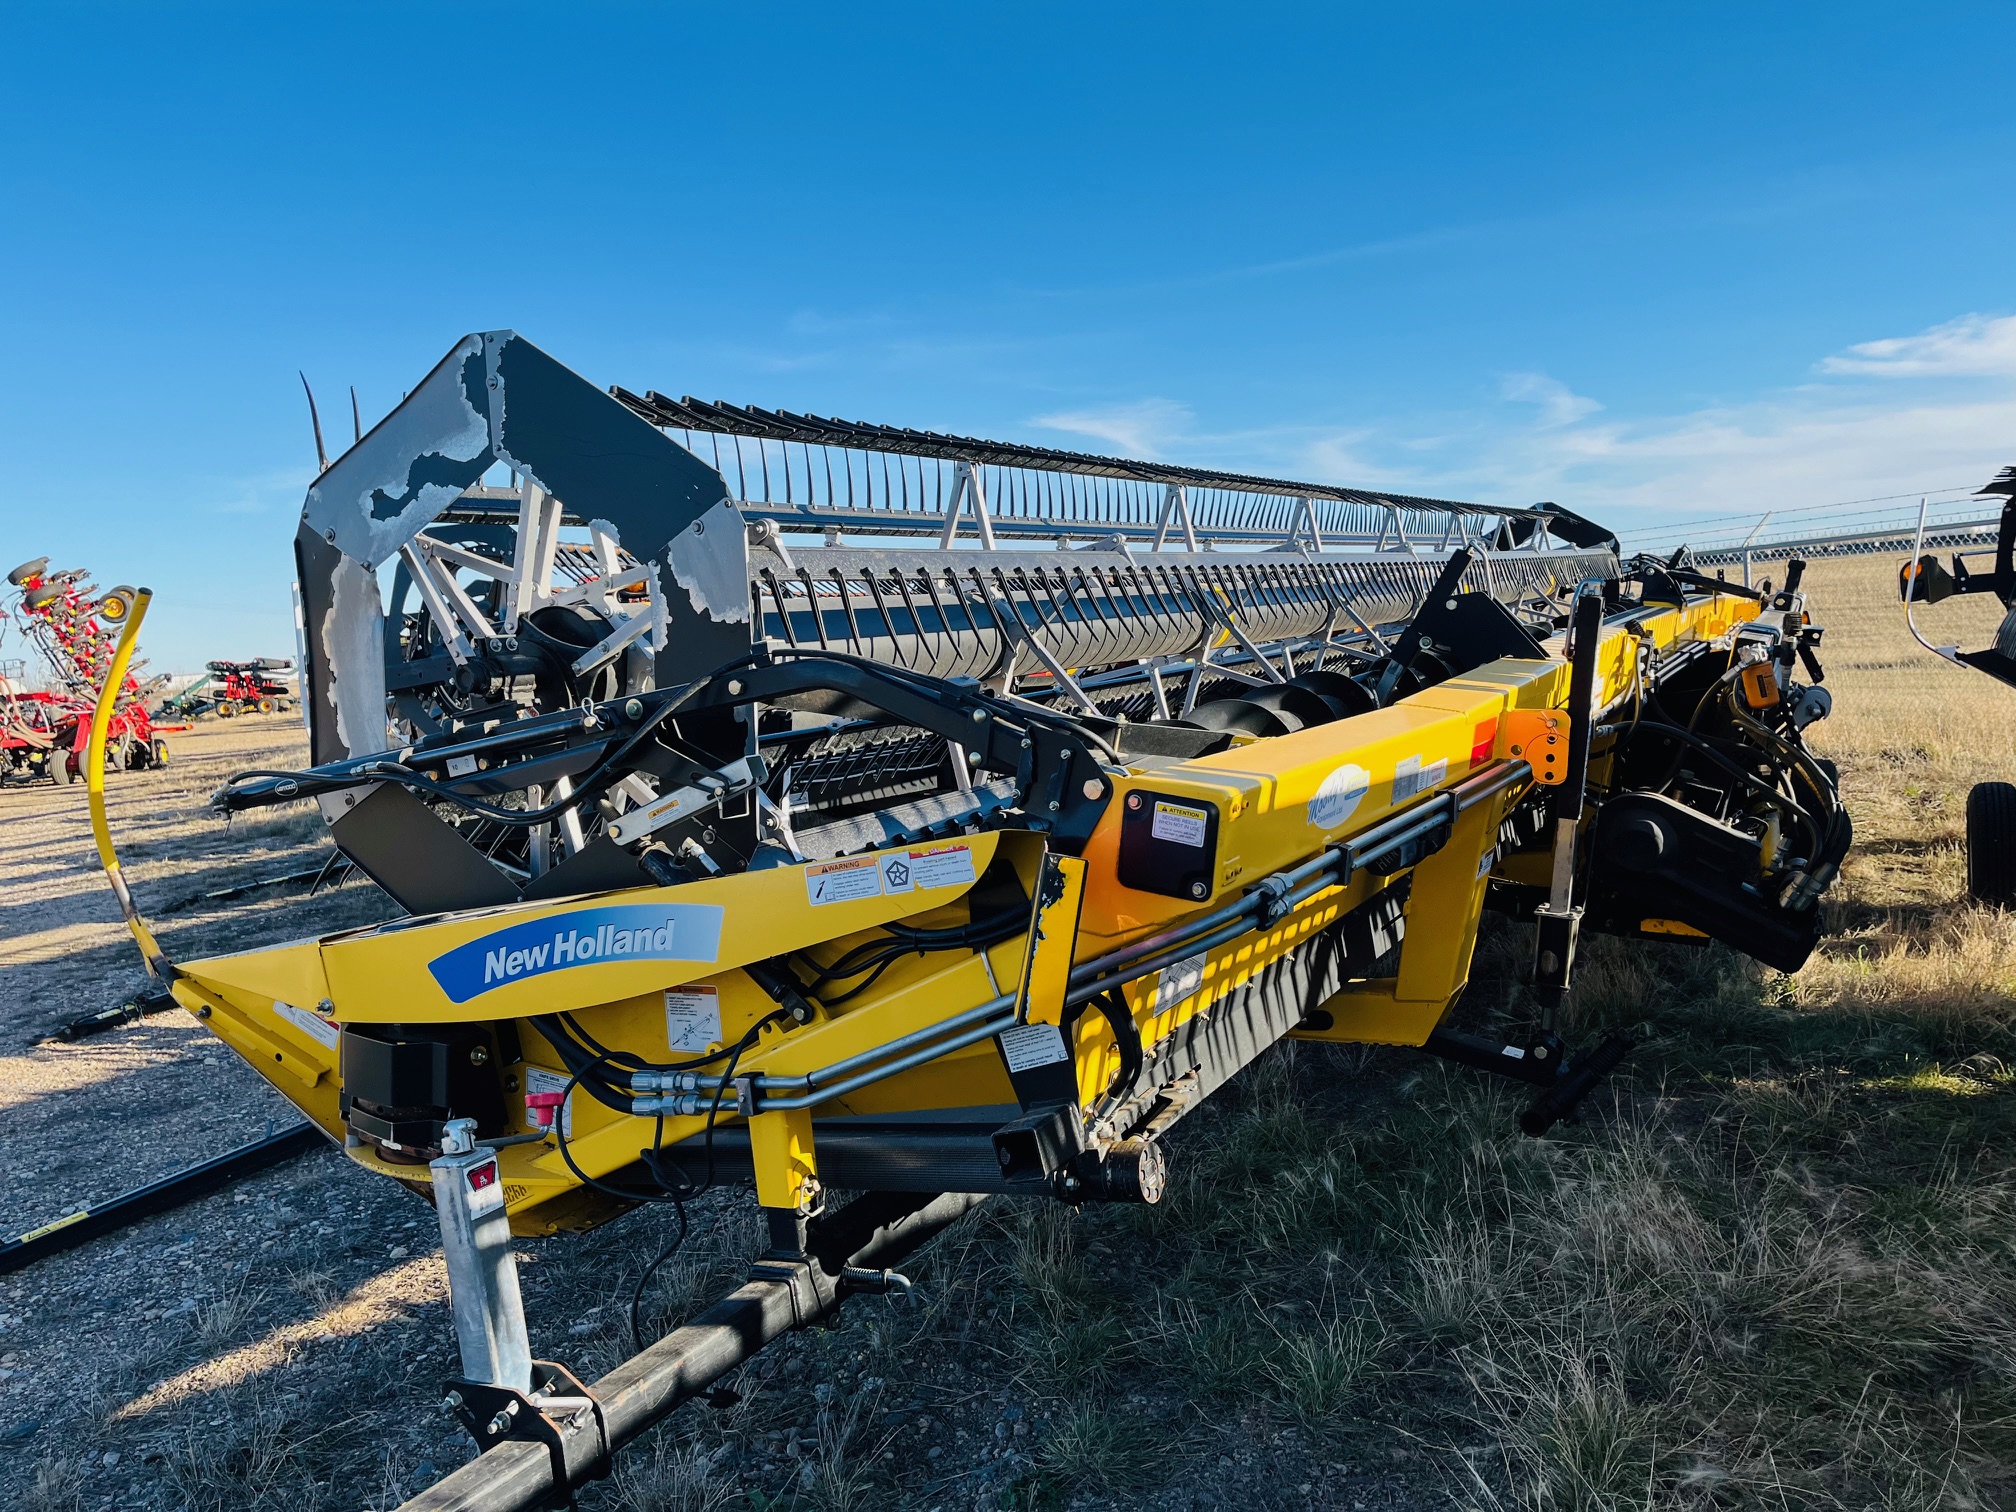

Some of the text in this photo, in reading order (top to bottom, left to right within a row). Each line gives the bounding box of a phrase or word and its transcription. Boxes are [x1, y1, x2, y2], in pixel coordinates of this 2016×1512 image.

[1169, 807, 1200, 818] ATTENTION
[828, 861, 860, 872] WARNING
[484, 919, 676, 984] New Holland
